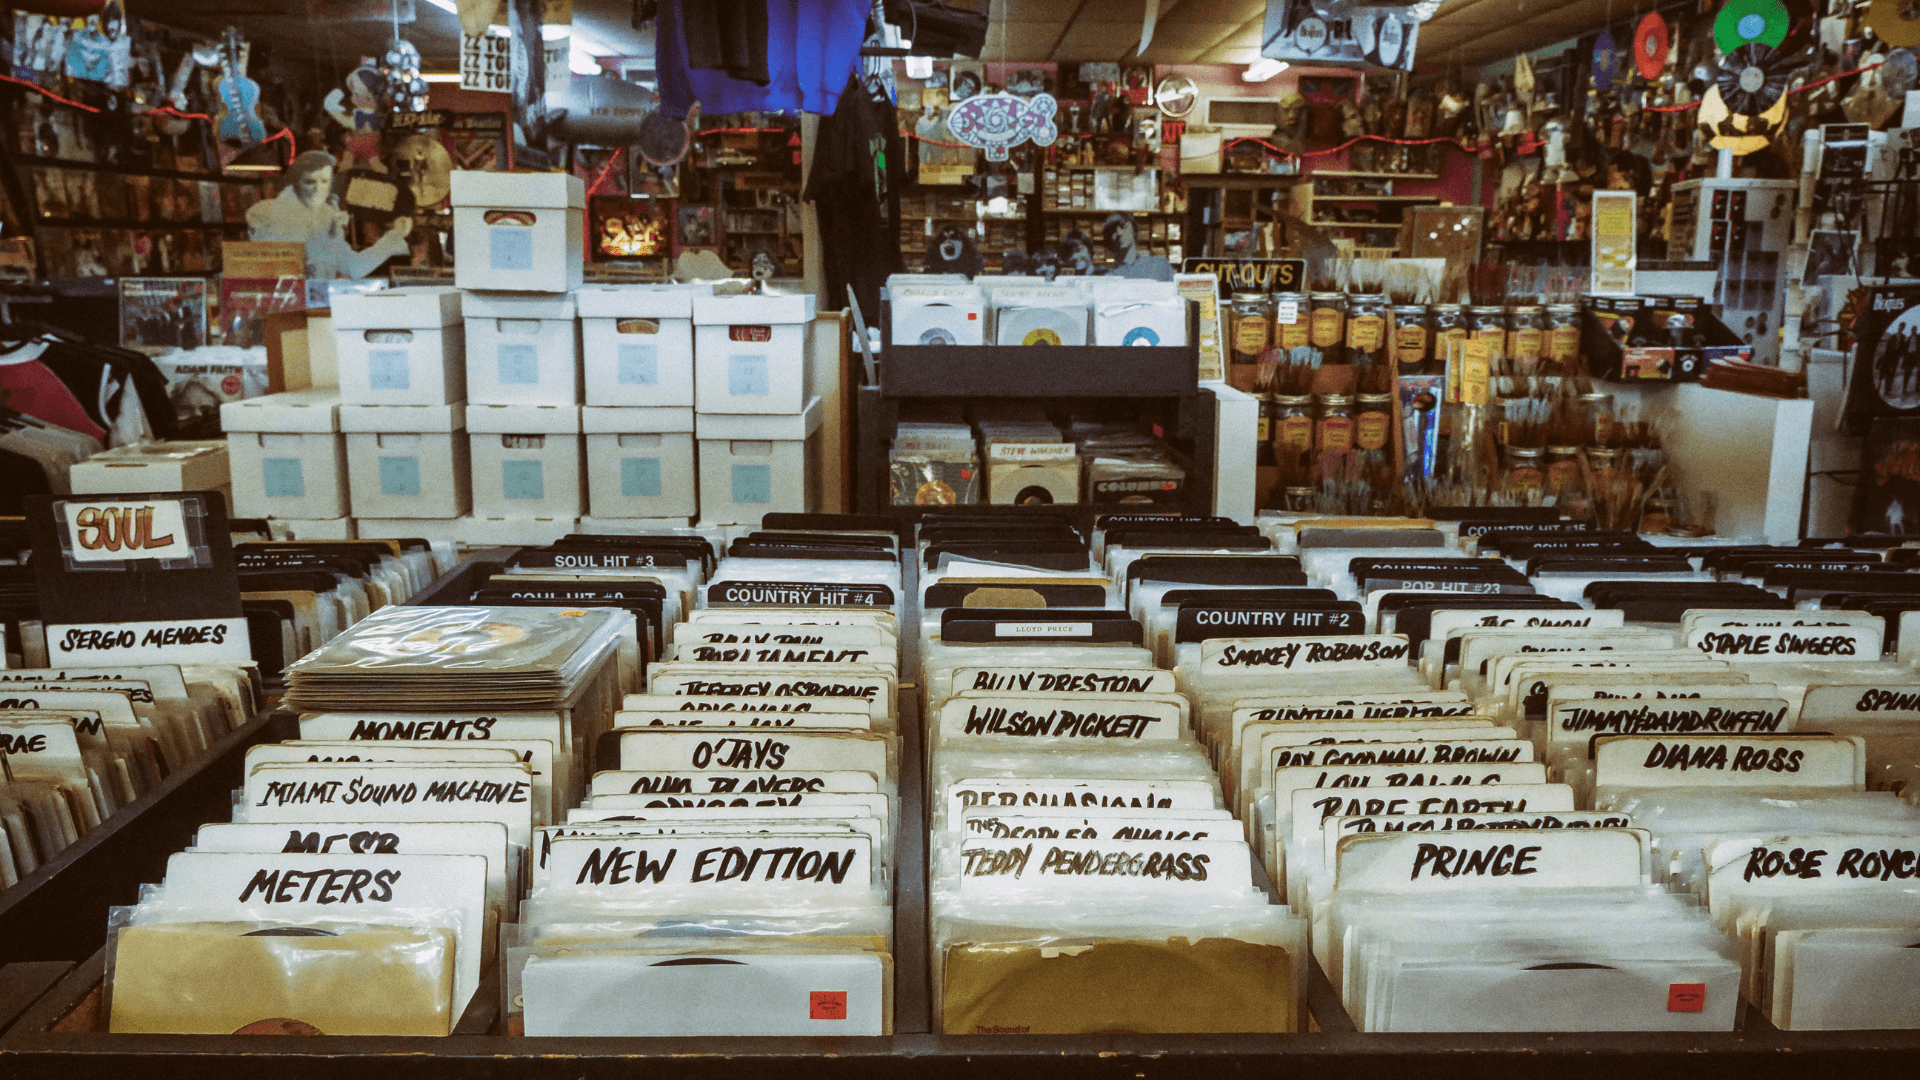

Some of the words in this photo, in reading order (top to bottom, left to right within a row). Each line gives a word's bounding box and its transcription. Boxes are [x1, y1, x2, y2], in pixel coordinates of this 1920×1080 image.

[1097, 480, 1178, 492] COLUMB
[76, 505, 174, 552] SOUL
[555, 555, 598, 568] SOUL
[603, 555, 629, 567] HIT
[635, 555, 655, 567] #3
[726, 588, 811, 603] COUNTRY
[820, 592, 848, 605] HIT
[854, 593, 875, 606] #4
[1196, 610, 1286, 626] COUNTRY
[1293, 612, 1324, 627] HIT
[1329, 613, 1350, 628] #2
[59, 629, 135, 652] SERGIO
[1218, 643, 1301, 669] SMOKEY
[1305, 640, 1409, 663] ROBINSON
[1697, 632, 1772, 655] STAPLE
[1775, 632, 1857, 656] SINGERS
[964, 705, 1057, 736] WILSON
[1052, 710, 1161, 739] PICKETT
[692, 738, 790, 770] O'JAYS
[1643, 742, 1728, 771] DIANA
[1731, 745, 1804, 773] ROSS
[343, 775, 417, 806] SOUND
[422, 780, 531, 804] MACHINE
[575, 846, 677, 886] NEW
[690, 845, 857, 884] EDITION
[961, 843, 1034, 880] TEDDY
[1039, 846, 1211, 882] PENDERGRASS
[1410, 843, 1542, 881] PRINCE
[1743, 847, 1828, 883] ROSE
[1836, 848, 1920, 881] ROYC
[238, 868, 401, 905] METERS
